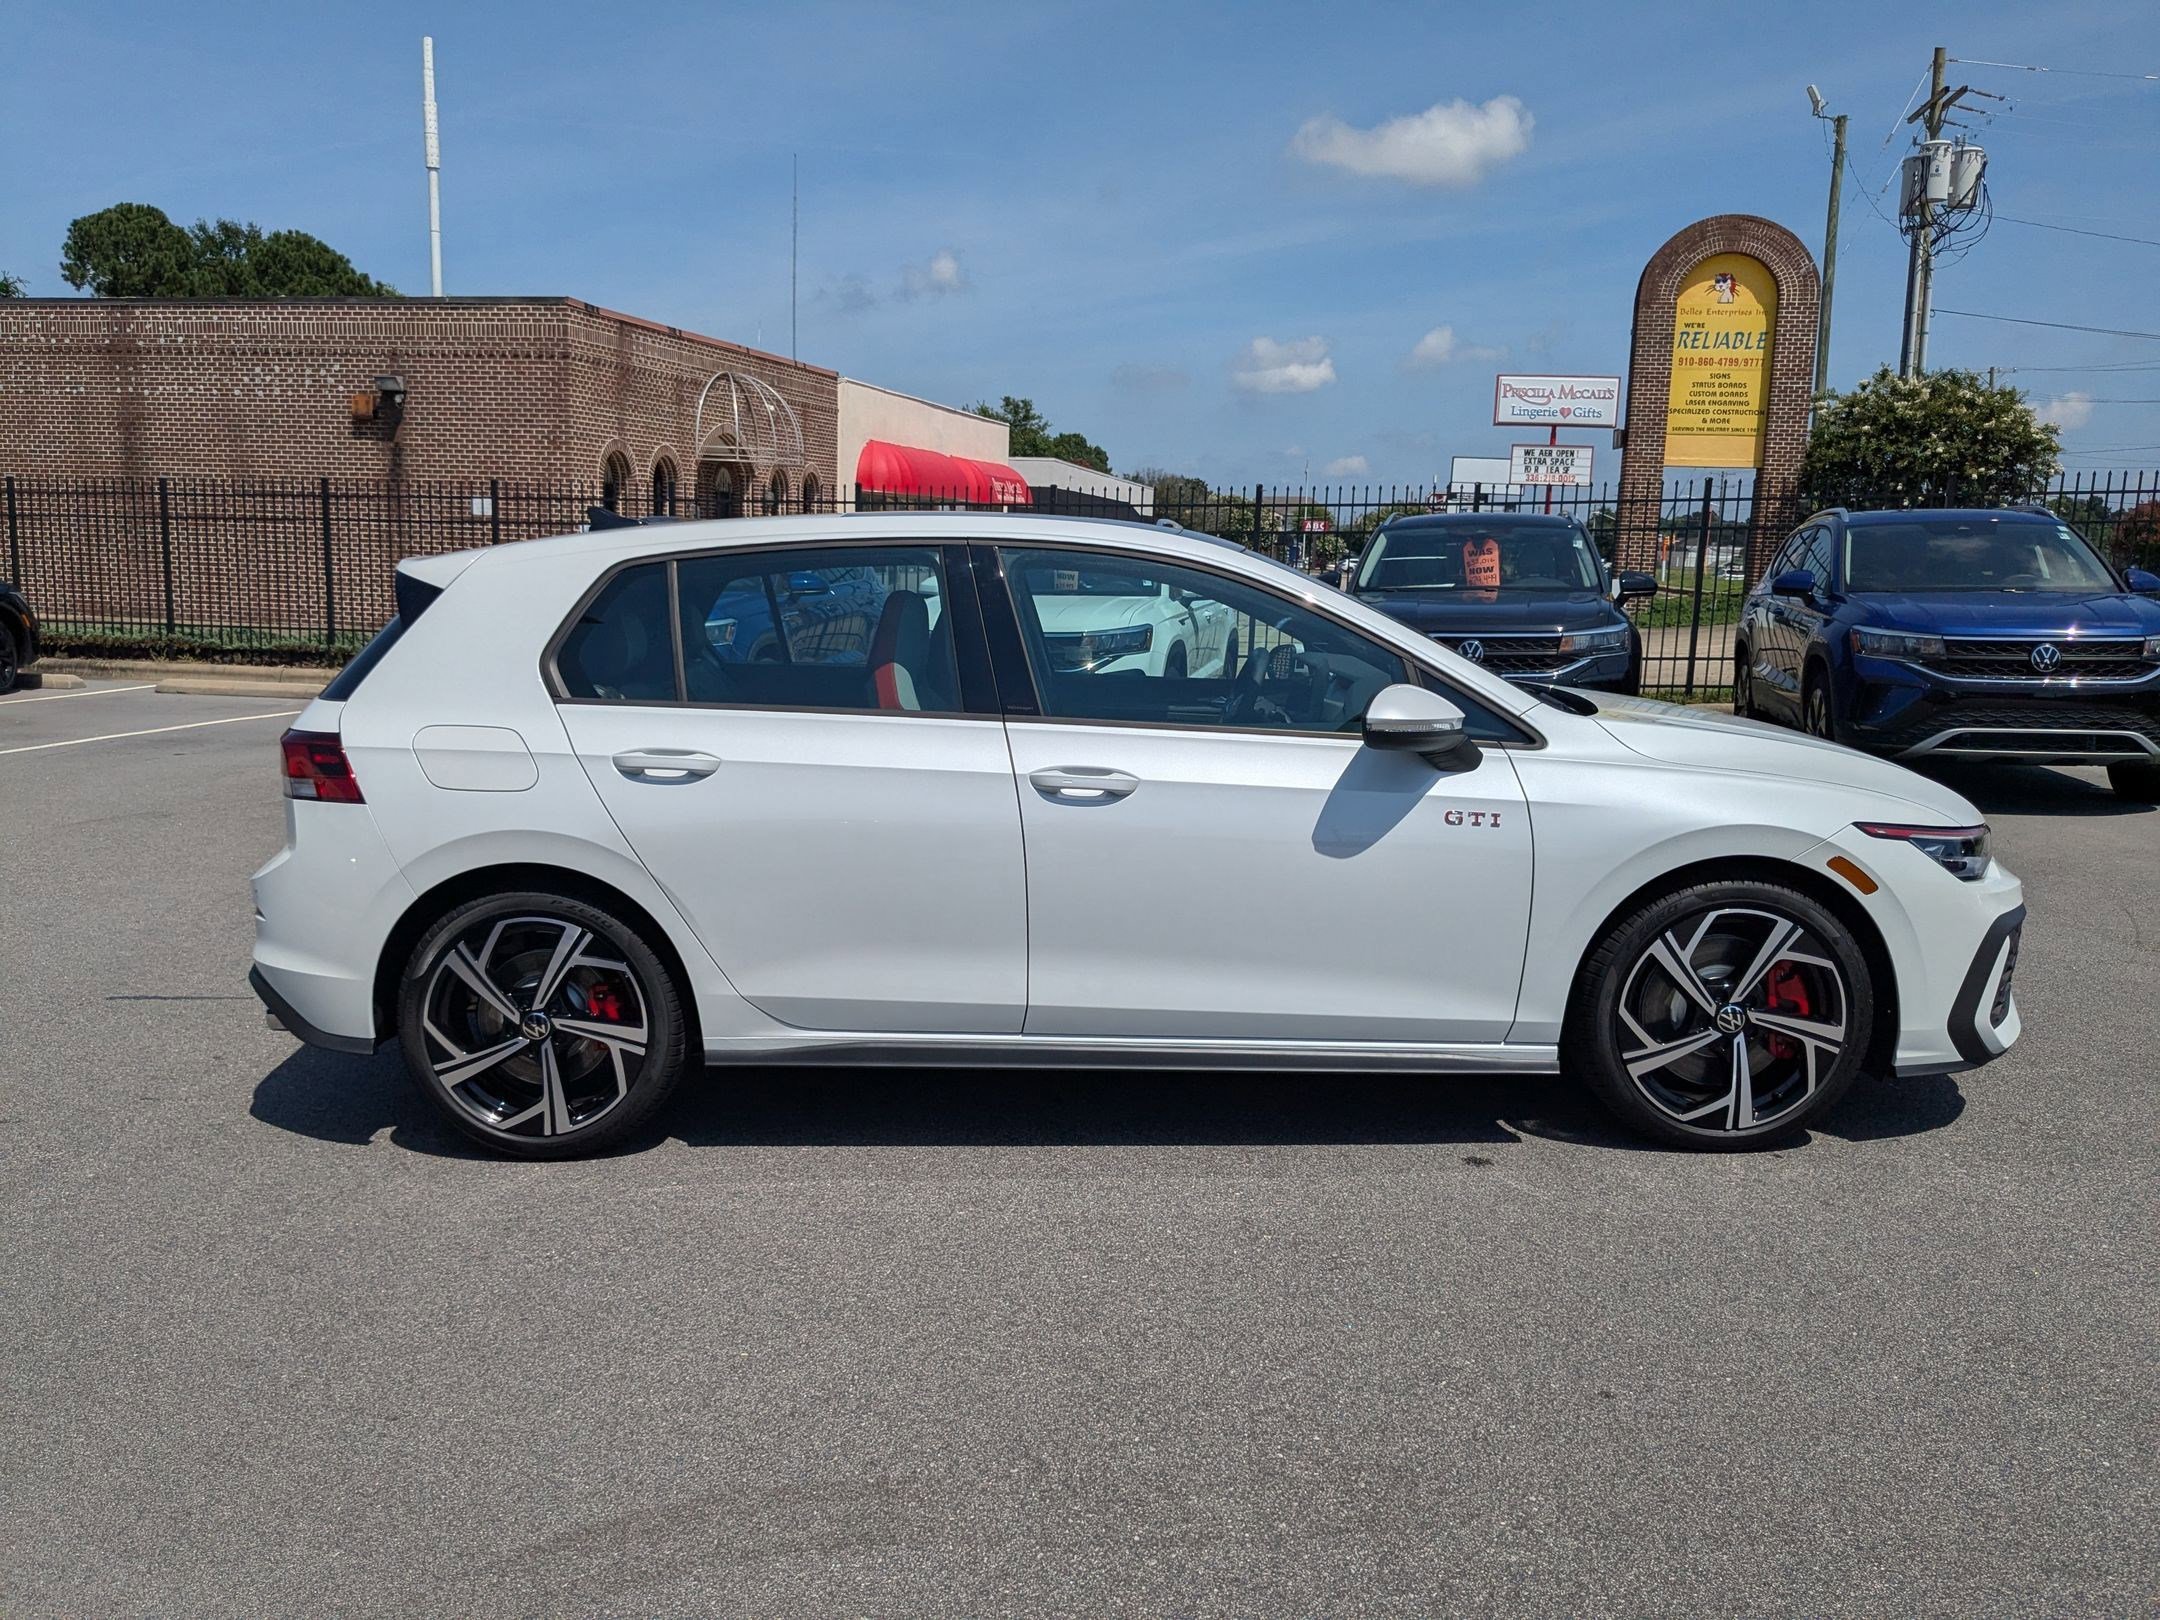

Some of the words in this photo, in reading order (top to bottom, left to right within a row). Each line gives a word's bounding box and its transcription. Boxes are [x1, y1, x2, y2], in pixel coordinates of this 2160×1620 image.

[1706, 308, 1753, 317] Enterprises
[1677, 331, 1769, 350] RELIABLE
[1502, 383, 1556, 404] PRISCILLA
[1511, 405, 1558, 420] Lingerie
[1573, 407, 1602, 418] Gifts
[1712, 408, 1765, 416] CONSTRUCTION
[1524, 449, 1535, 457] WE
[1523, 458, 1547, 466] EXTRA
[1550, 458, 1575, 466] SPACE
[1305, 520, 1325, 529] ABC
[1468, 548, 1493, 557] WAS
[1469, 566, 1494, 575] NOW
[1444, 810, 1502, 828] GTI
